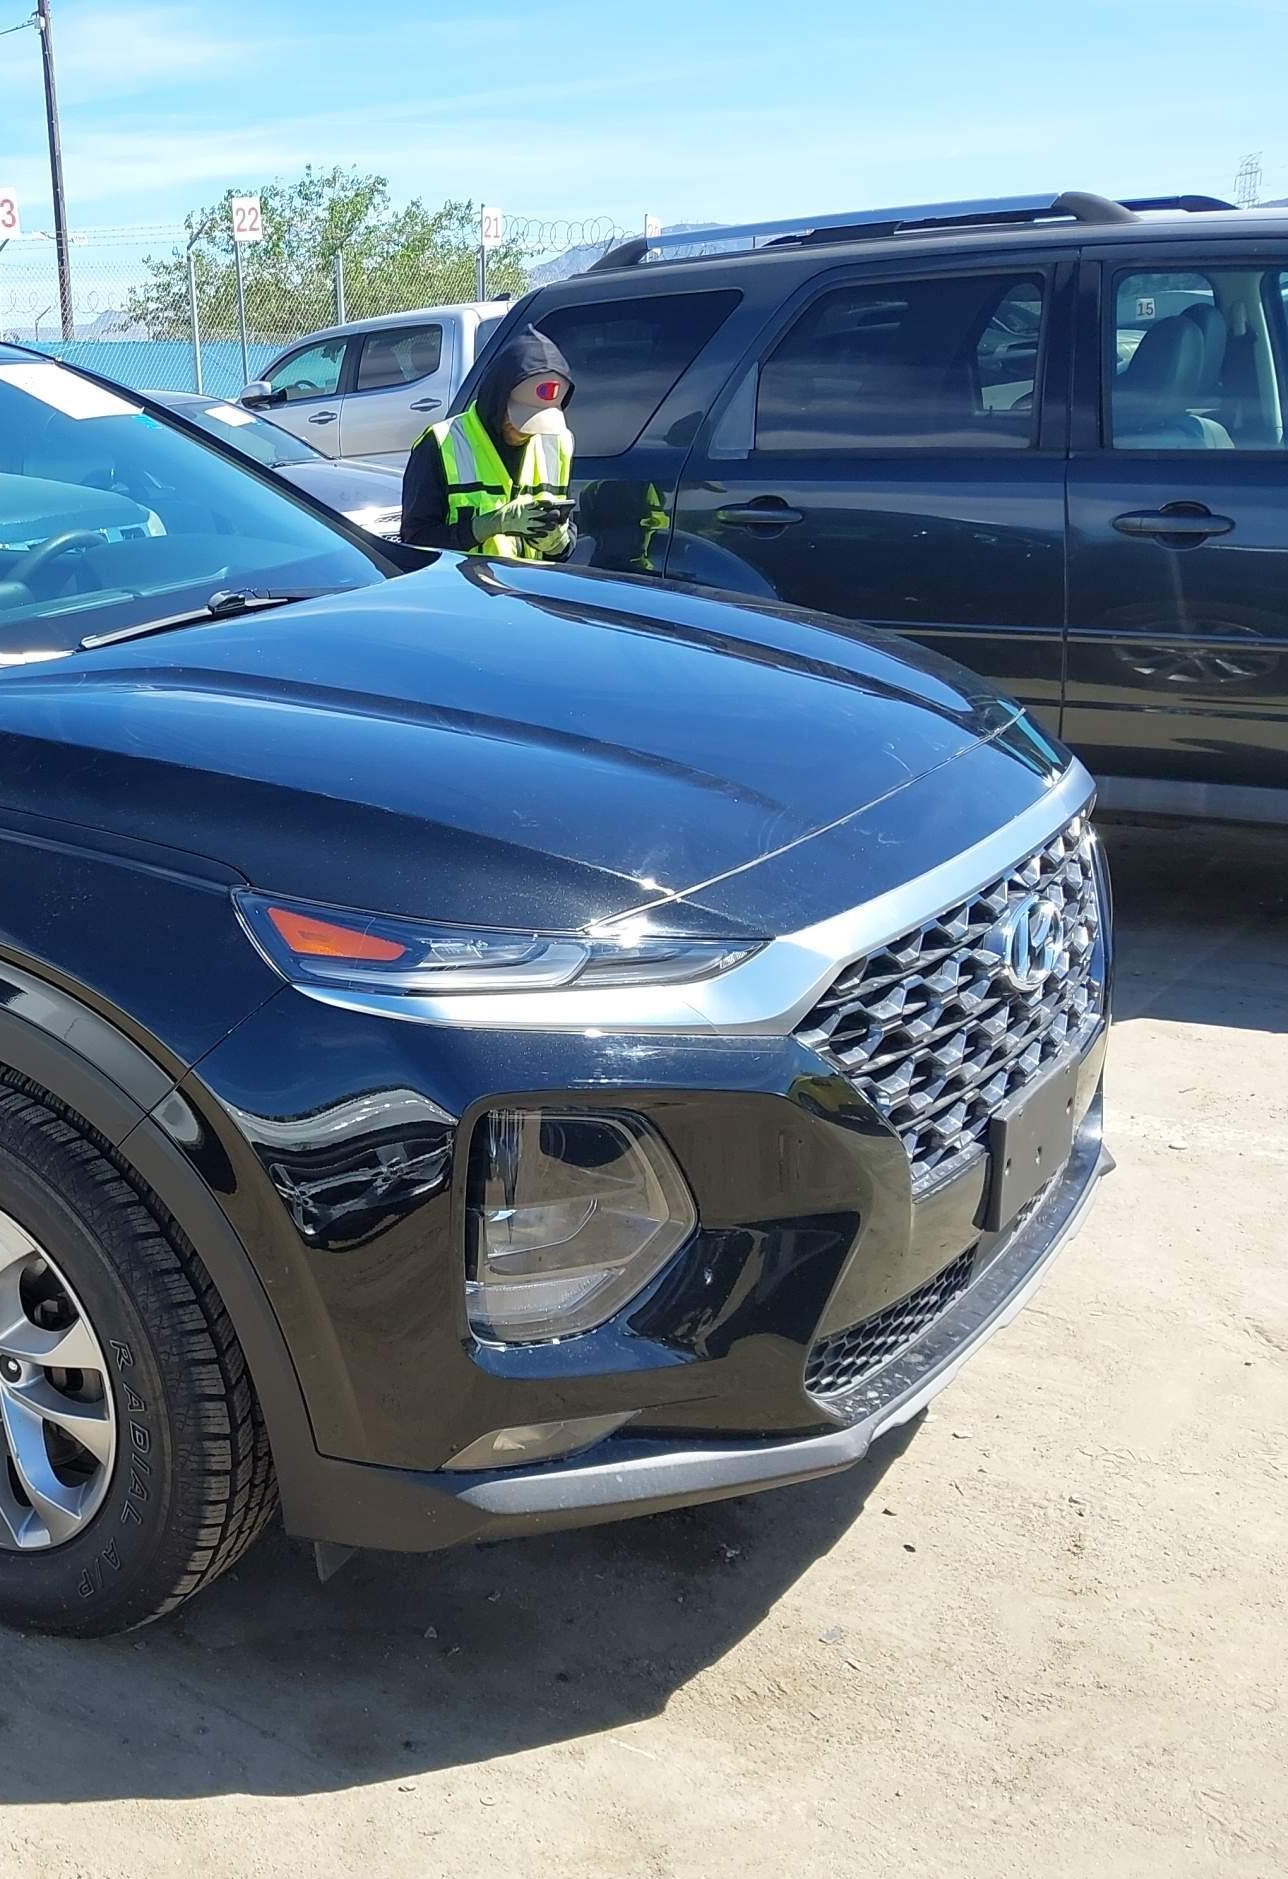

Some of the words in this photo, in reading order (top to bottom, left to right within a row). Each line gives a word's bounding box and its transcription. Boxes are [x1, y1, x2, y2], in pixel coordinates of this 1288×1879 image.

[235, 207, 260, 232] 22
[484, 216, 500, 238] 21
[1137, 302, 1154, 316] 15
[110, 1338, 151, 1525] RADIAL
[78, 1536, 121, 1598] A/P
